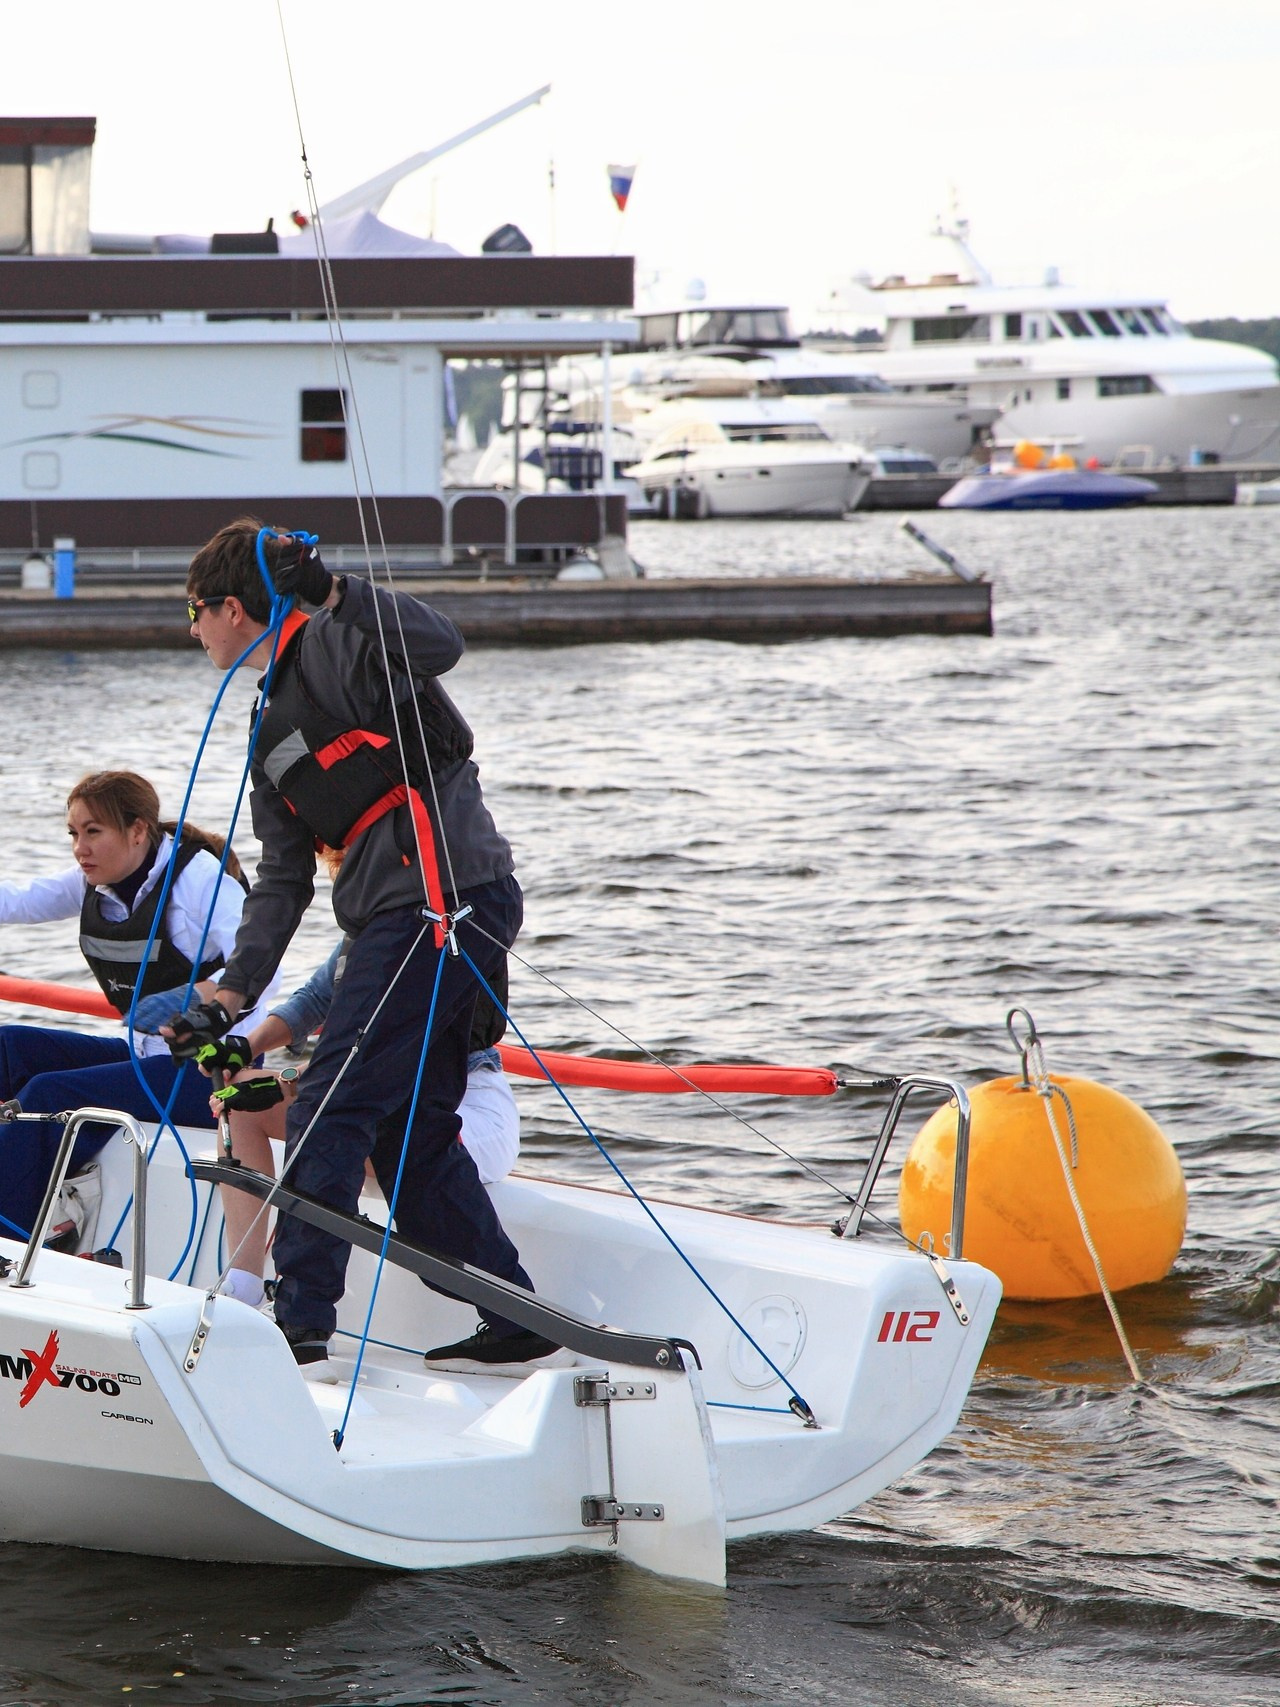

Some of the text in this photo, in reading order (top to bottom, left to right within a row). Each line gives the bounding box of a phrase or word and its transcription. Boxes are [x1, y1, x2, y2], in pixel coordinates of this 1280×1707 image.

[877, 1311, 940, 1342] 112
[55, 1364, 118, 1380] SAILING BOATS
[101, 1411, 154, 1425] CARBON
